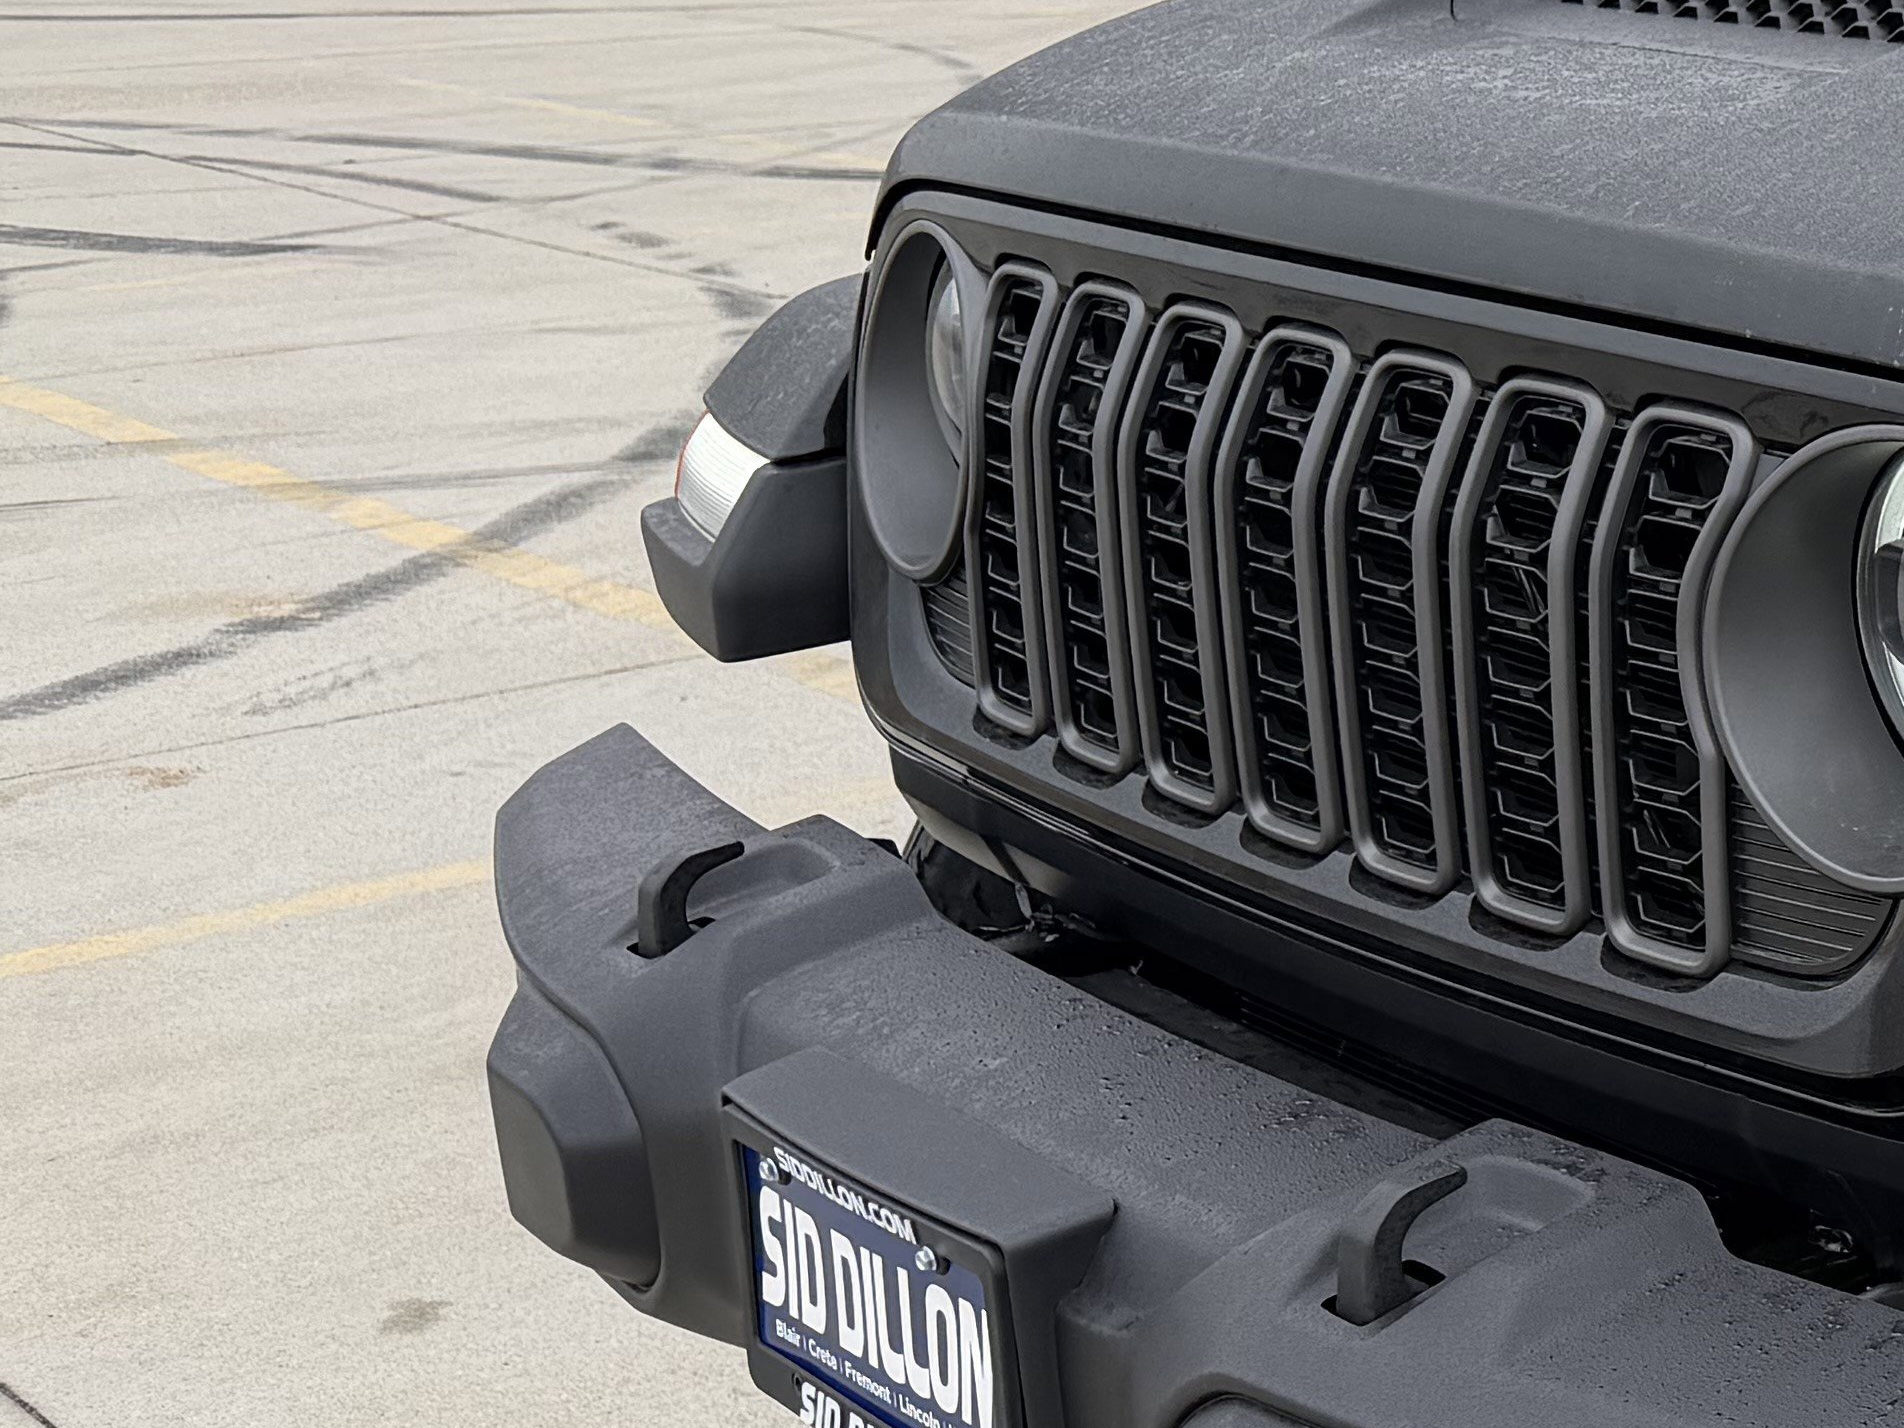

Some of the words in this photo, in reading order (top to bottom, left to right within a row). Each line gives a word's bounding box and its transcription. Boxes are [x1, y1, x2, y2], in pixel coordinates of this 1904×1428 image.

[773, 1146, 918, 1246] SIDDILLON.COM
[759, 1184, 827, 1336] SID
[775, 1318, 802, 1348] Blair
[807, 1337, 838, 1371] Crete
[844, 1360, 892, 1406] Fremont
